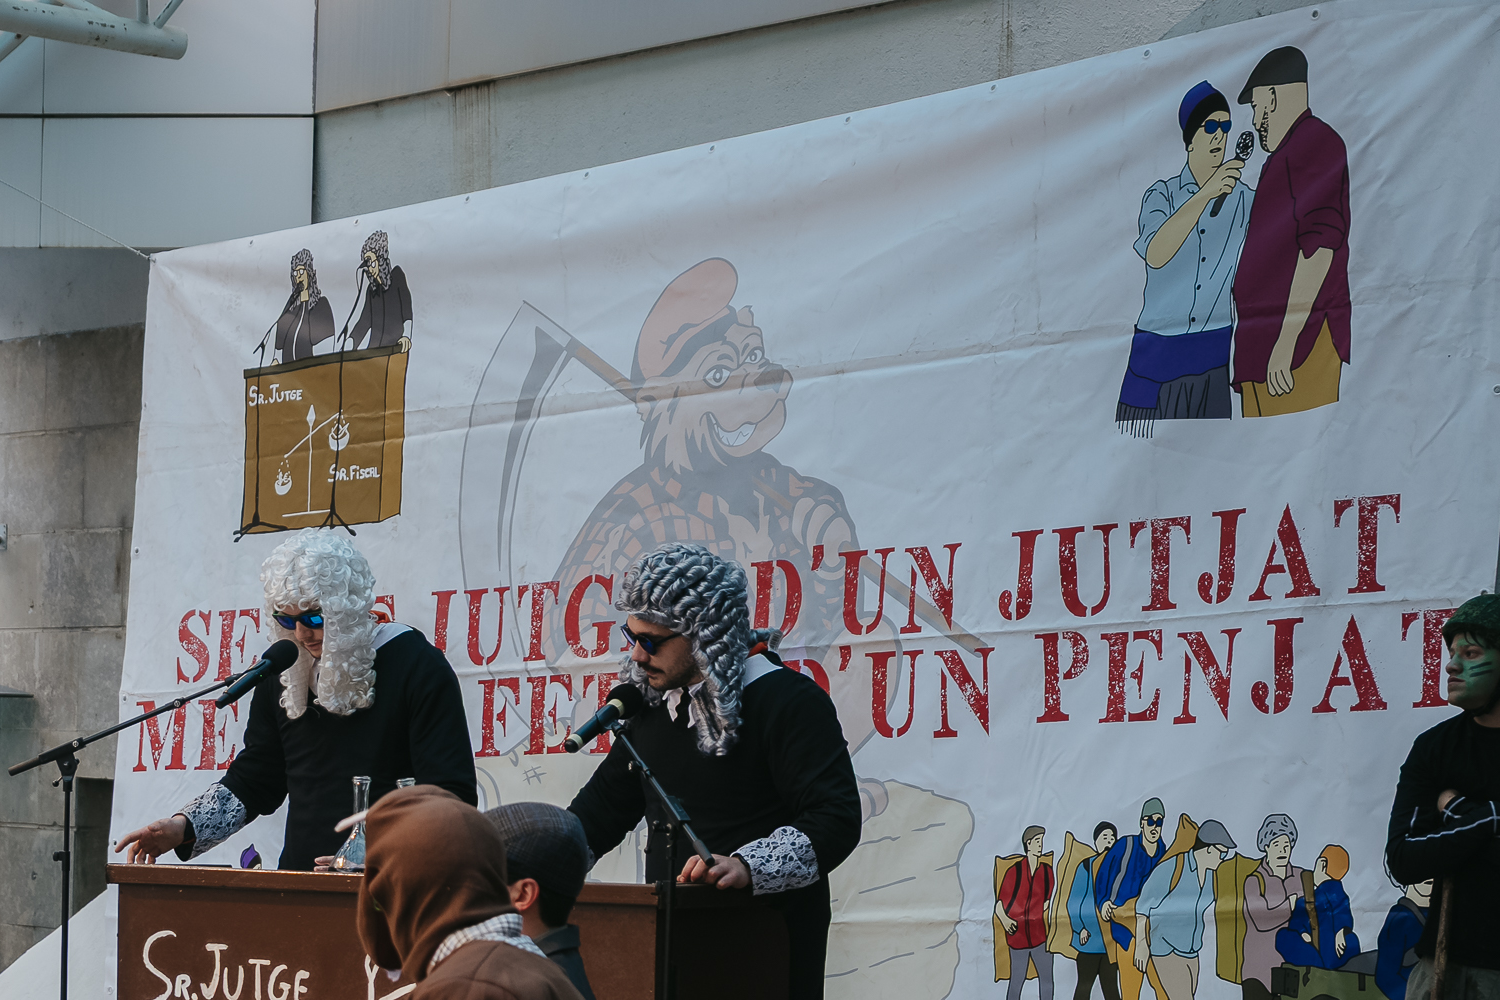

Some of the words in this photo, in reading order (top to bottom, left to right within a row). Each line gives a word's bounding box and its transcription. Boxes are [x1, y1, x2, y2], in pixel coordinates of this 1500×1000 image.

[750, 543, 963, 638] D'UN
[998, 493, 1401, 622] JUTJAT
[782, 645, 995, 739] 'UN
[1034, 607, 1459, 725] PENJAT
